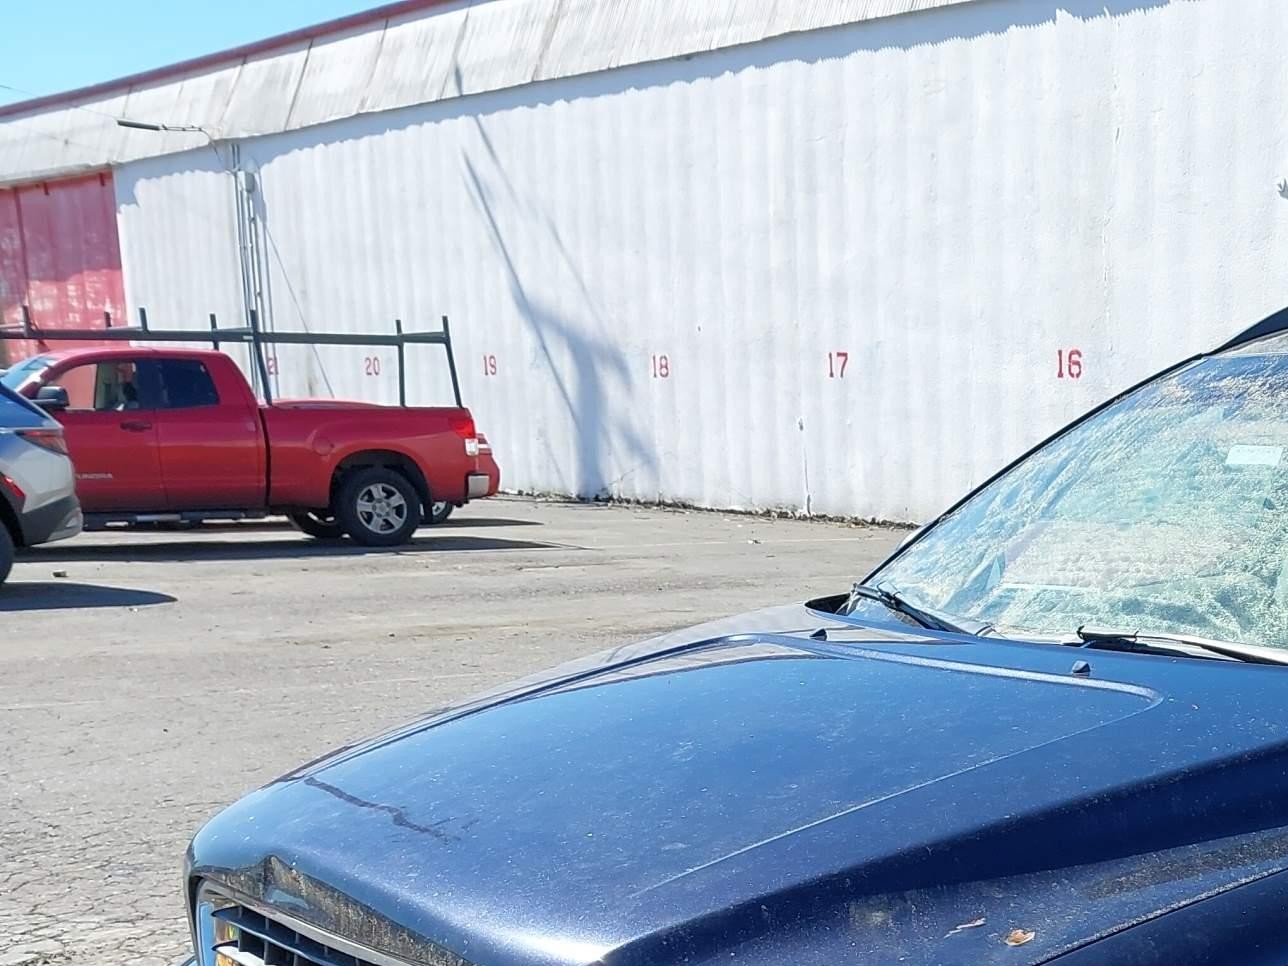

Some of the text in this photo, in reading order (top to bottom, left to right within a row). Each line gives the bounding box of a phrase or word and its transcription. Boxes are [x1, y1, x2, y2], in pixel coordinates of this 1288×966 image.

[364, 356, 381, 376] 20
[483, 355, 497, 376] 19
[652, 355, 670, 378] 18
[828, 352, 849, 378] 17
[1057, 349, 1082, 379] 16
